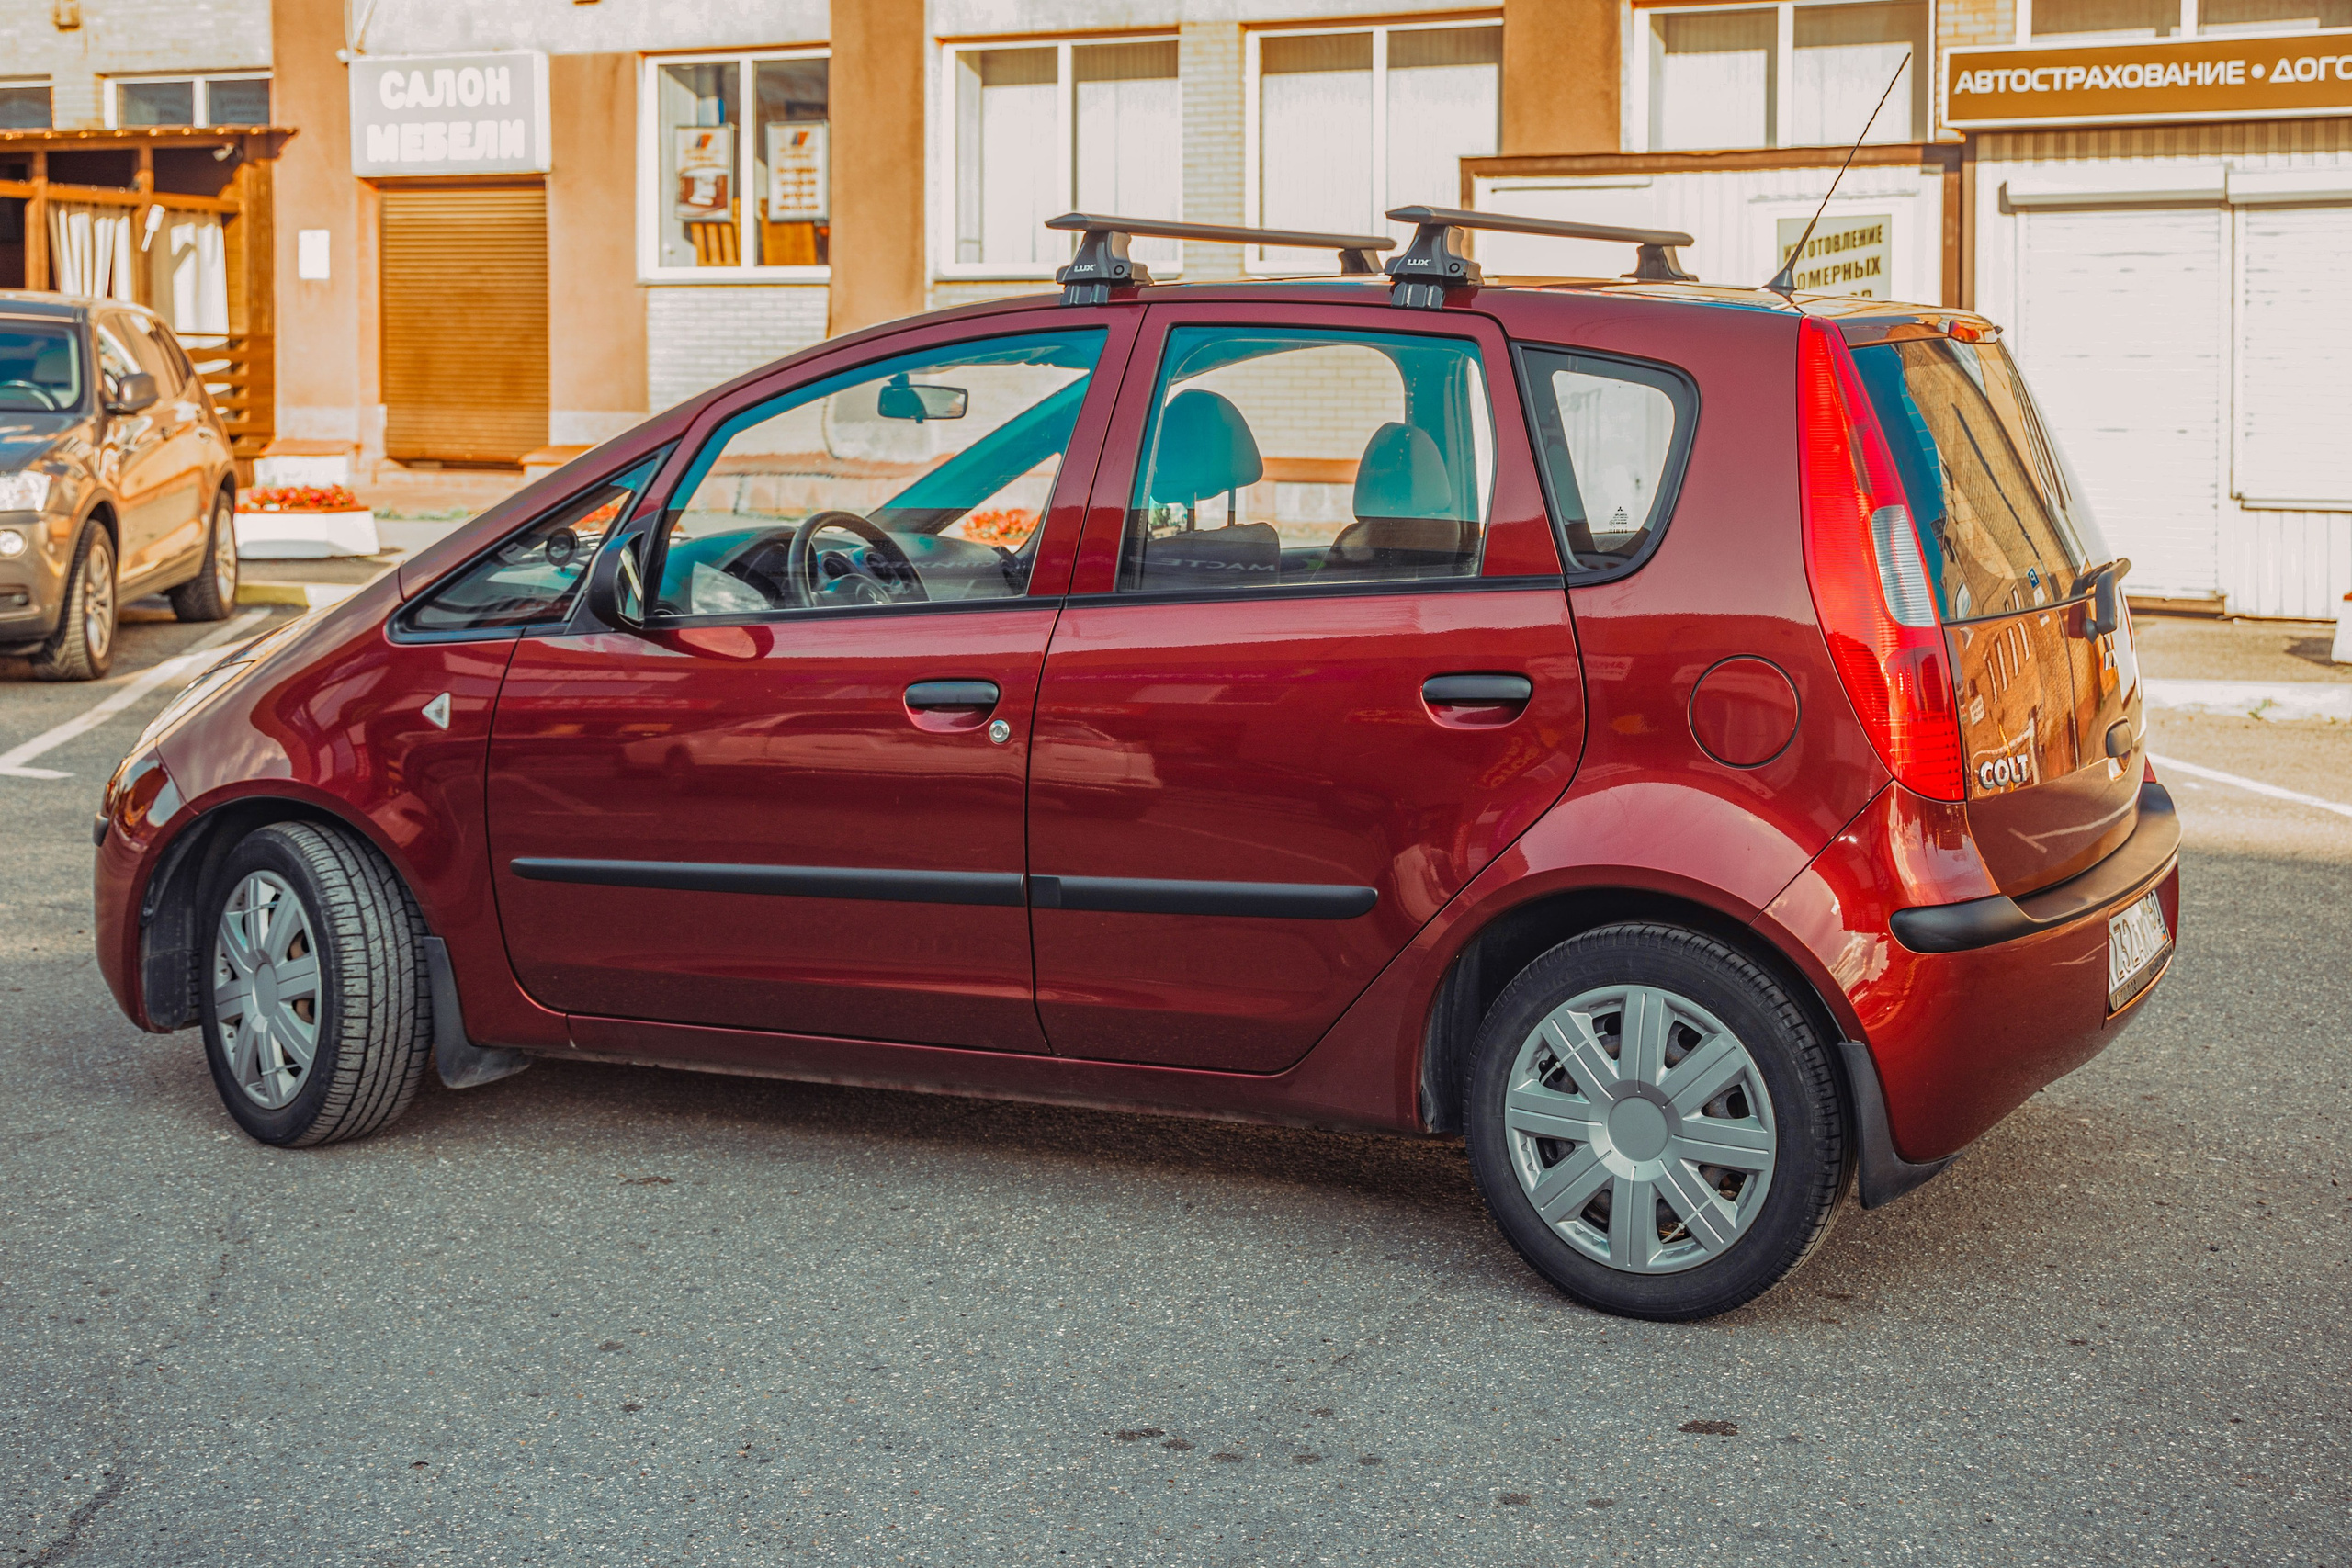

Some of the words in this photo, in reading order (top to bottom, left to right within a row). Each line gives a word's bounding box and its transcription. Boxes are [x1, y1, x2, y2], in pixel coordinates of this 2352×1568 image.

[379, 66, 511, 110] САЛОН
[1954, 60, 2247, 95] АВТОСТРАХОВАНИЕ
[367, 118, 526, 163] МЕБЕЛИ
[1783, 224, 1882, 263] ИОТОВЛЕНИЕ
[1074, 264, 1094, 273] LUX
[1407, 258, 1429, 266] LUX
[1796, 256, 1881, 290] ОМЕРНЫХ
[1978, 754, 2029, 790] COLT
